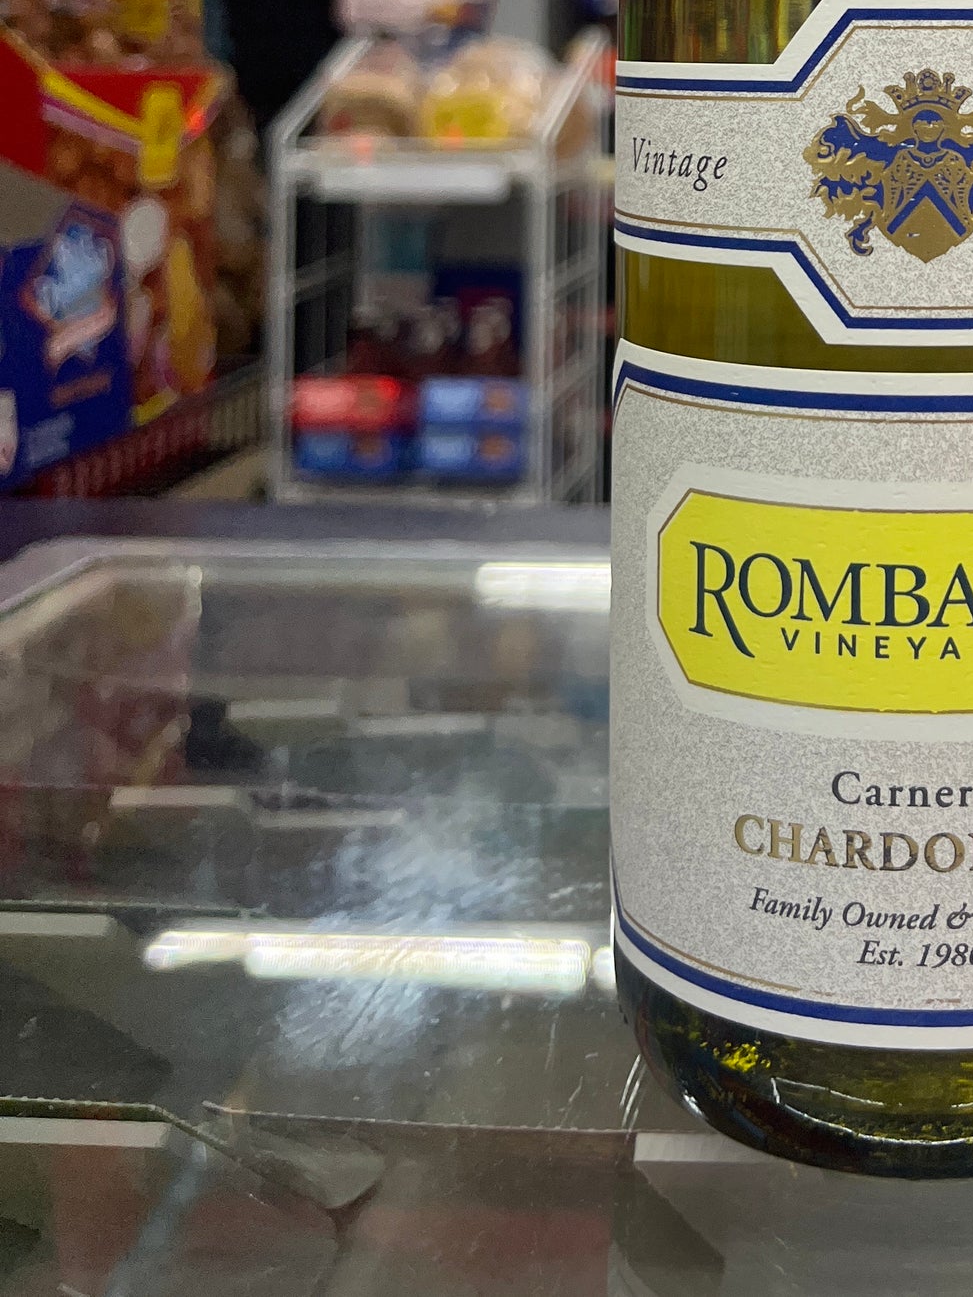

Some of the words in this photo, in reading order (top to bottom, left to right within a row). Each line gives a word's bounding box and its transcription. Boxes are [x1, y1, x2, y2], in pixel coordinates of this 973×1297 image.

[630, 137, 728, 191] Vintage
[749, 887, 832, 931] Family
[842, 902, 938, 931] Owned
[947, 905, 973, 931] &
[857, 940, 905, 967] Est.
